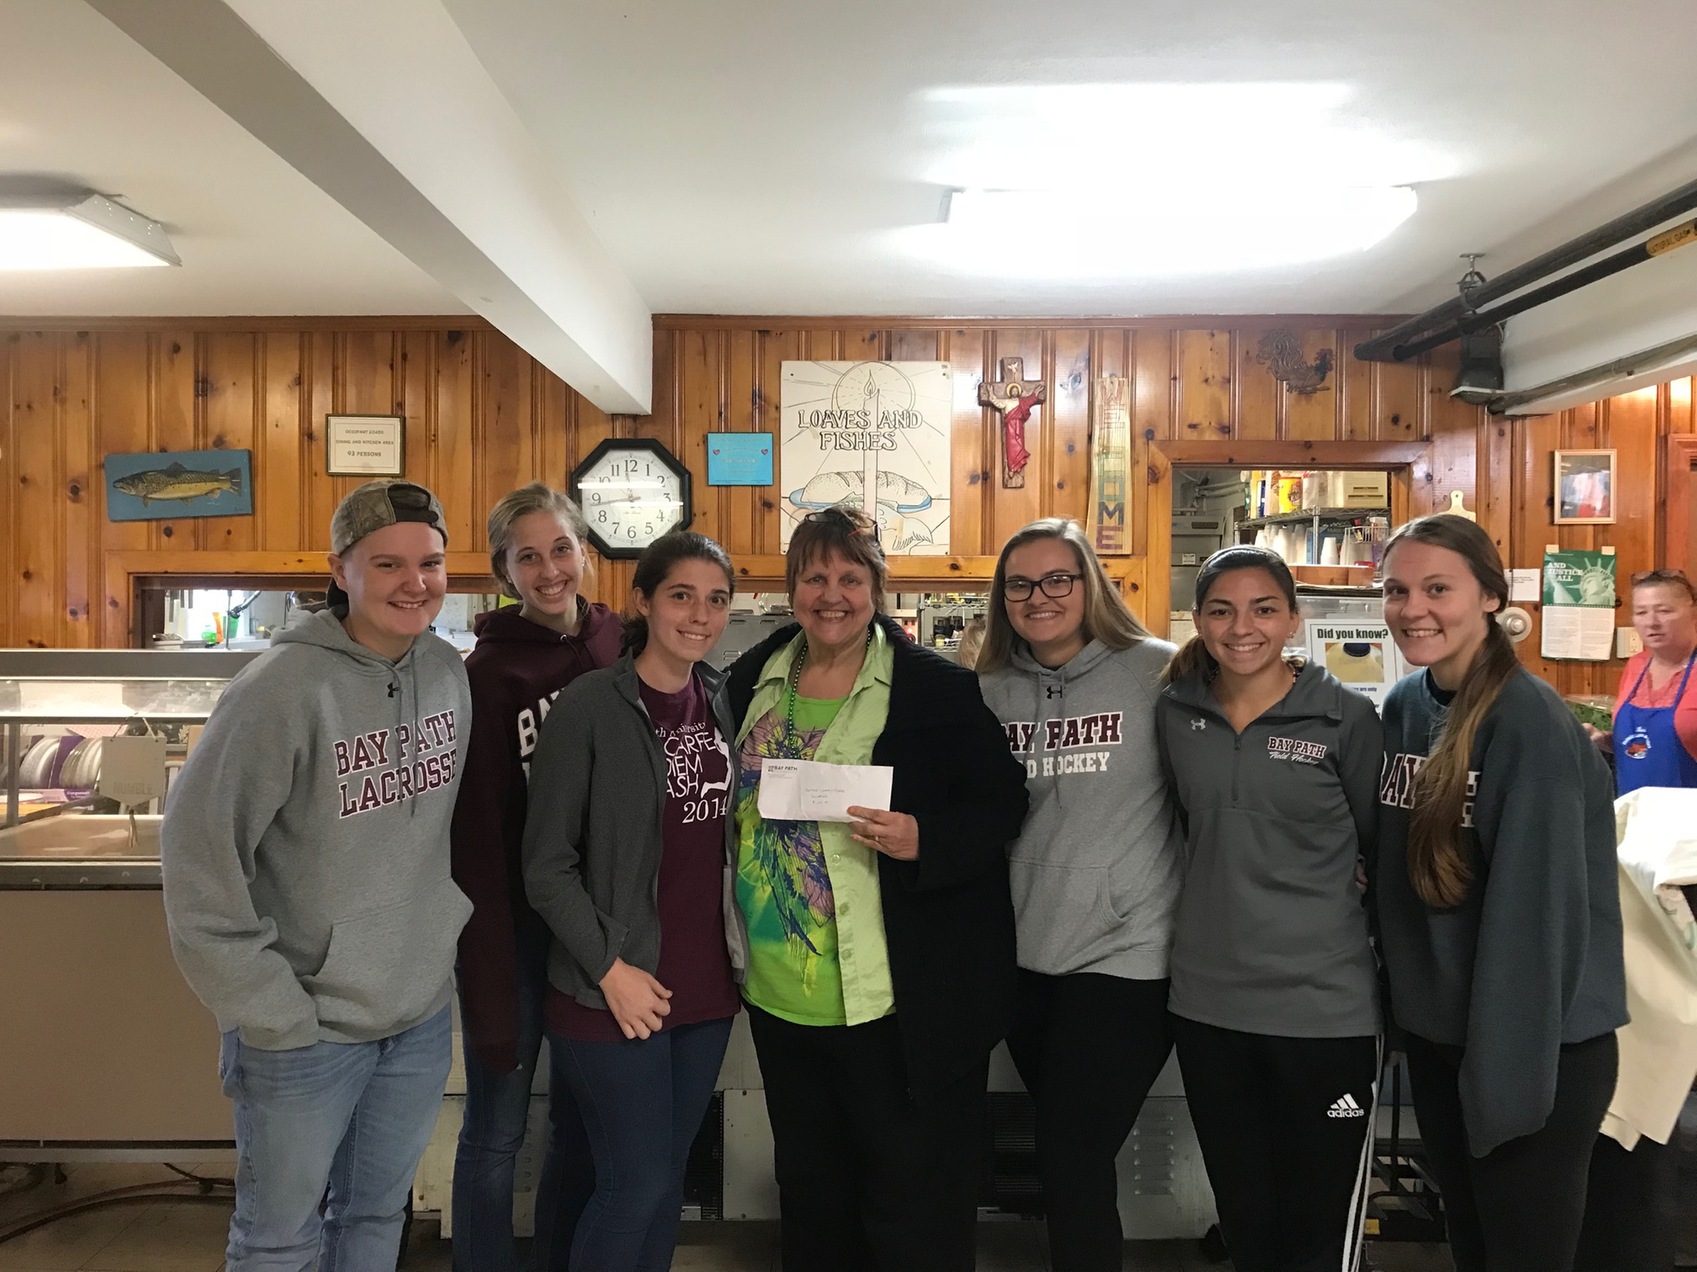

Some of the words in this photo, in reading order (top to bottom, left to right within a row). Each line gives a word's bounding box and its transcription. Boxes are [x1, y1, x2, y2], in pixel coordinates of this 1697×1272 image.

[798, 409, 871, 429] LOAVES
[878, 409, 923, 429] AND
[820, 431, 898, 451] FISHES
[611, 464, 620, 476] 11
[625, 460, 638, 472] 12
[646, 464, 650, 476] 1
[1095, 379, 1125, 550] WELCOME
[657, 476, 666, 488] 2
[592, 493, 601, 504] 9
[664, 493, 671, 502] 3
[598, 510, 607, 523] 8
[656, 510, 665, 522] 4
[612, 522, 620, 534] 7
[627, 526, 636, 538] 6
[645, 522, 654, 534] 5
[1317, 628, 1334, 638] Did
[1335, 630, 1354, 640] you
[1356, 628, 1388, 638] know?
[1001, 722, 1040, 754] AY
[1044, 711, 1123, 751] PATH
[333, 729, 389, 778] BAY
[394, 708, 456, 760] PATH
[1268, 736, 1293, 752] BAY
[1293, 740, 1327, 759] PATH
[1042, 752, 1110, 776] HOCKEY
[1291, 754, 1319, 765] Hockey
[339, 747, 457, 819] LACROSSE
[666, 773, 699, 798] ASH
[1379, 750, 1427, 810] AY
[682, 796, 728, 824] 2014
[1327, 1108, 1365, 1118] adidas
